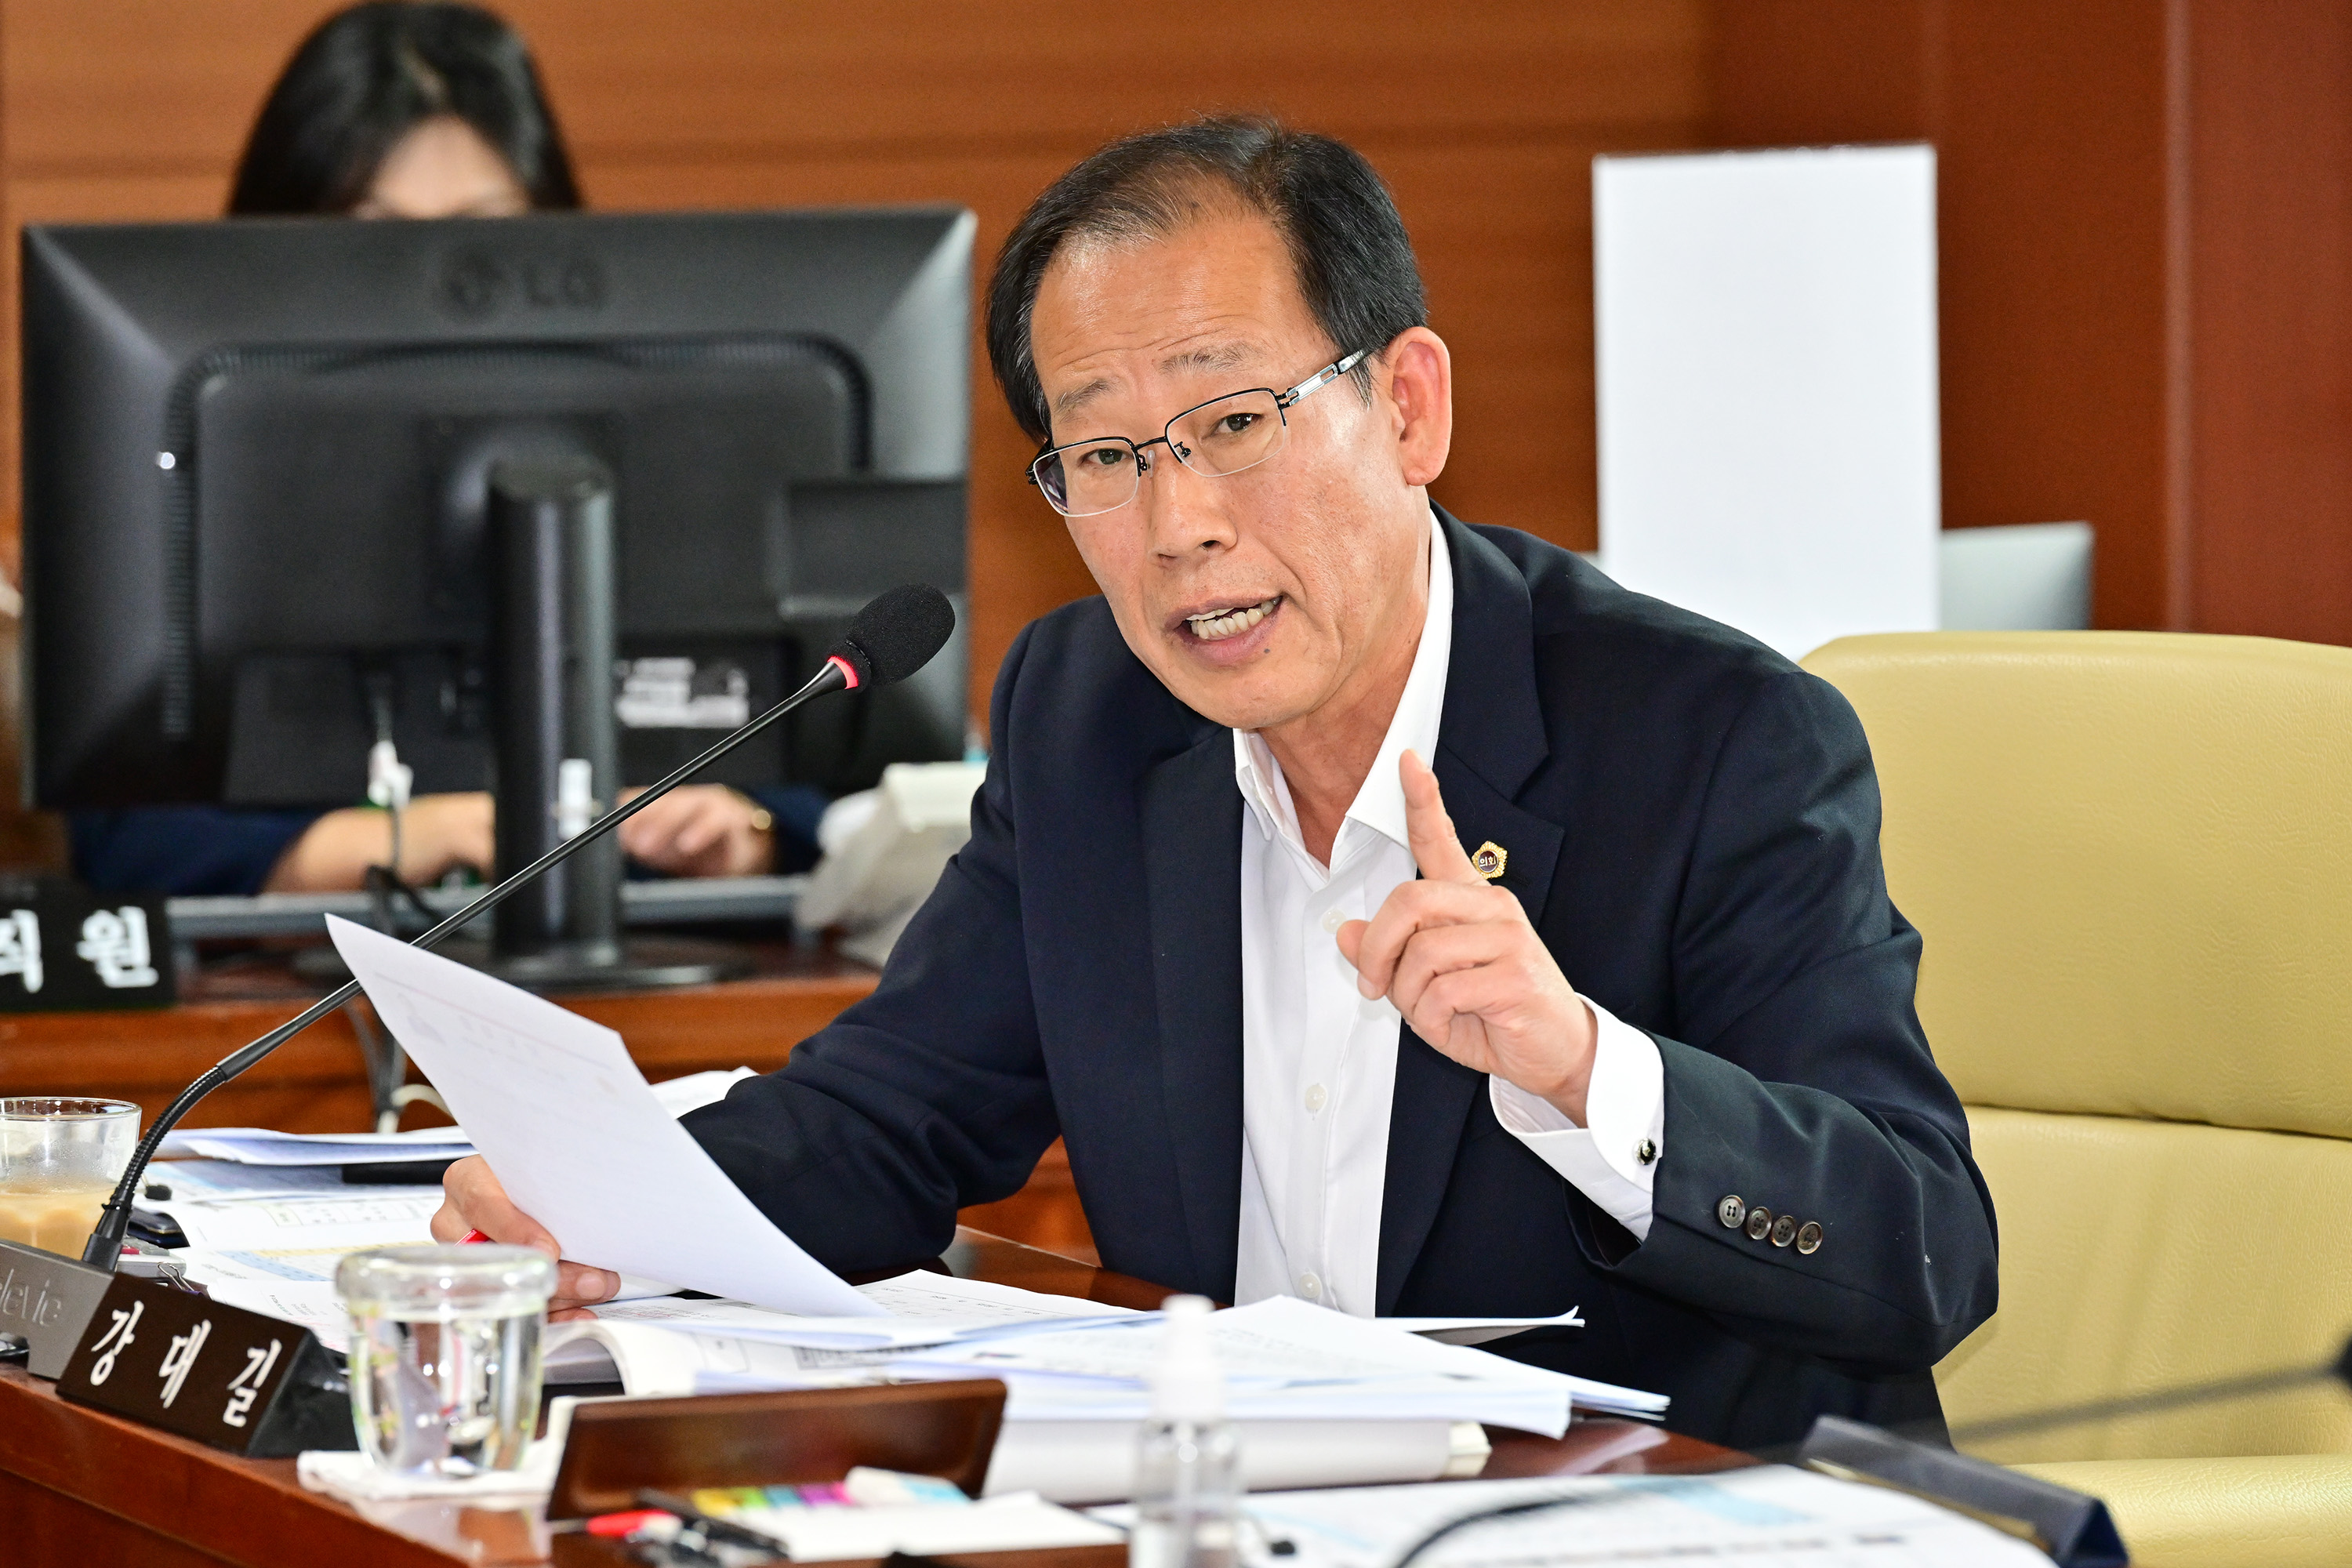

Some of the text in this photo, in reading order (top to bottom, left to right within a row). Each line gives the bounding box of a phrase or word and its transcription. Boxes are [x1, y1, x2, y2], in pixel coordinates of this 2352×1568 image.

[521, 260, 608, 307] LG
[1479, 855, 1497, 867] 의회
[90, 1300, 282, 1428] 강대길
